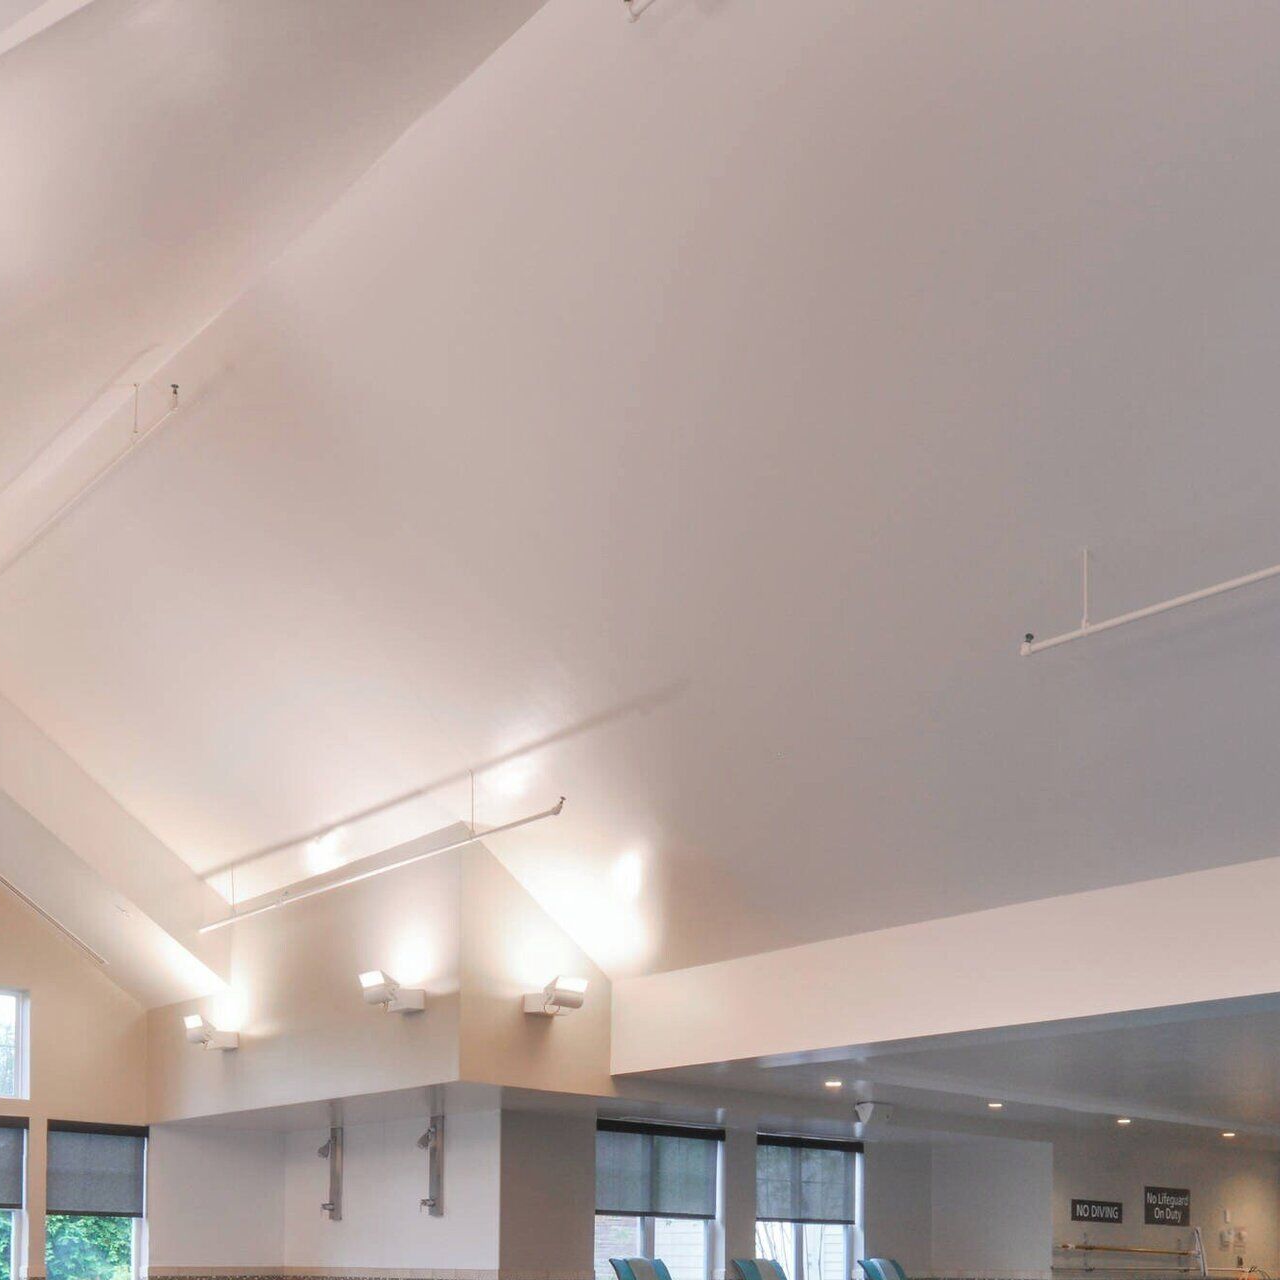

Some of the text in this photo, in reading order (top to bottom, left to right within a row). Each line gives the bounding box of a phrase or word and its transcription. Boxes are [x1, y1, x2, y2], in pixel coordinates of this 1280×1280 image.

[1147, 1192, 1189, 1208] No Lifeguard
[1076, 1204, 1119, 1219] NO DIVING
[1154, 1207, 1183, 1222] On Duty
